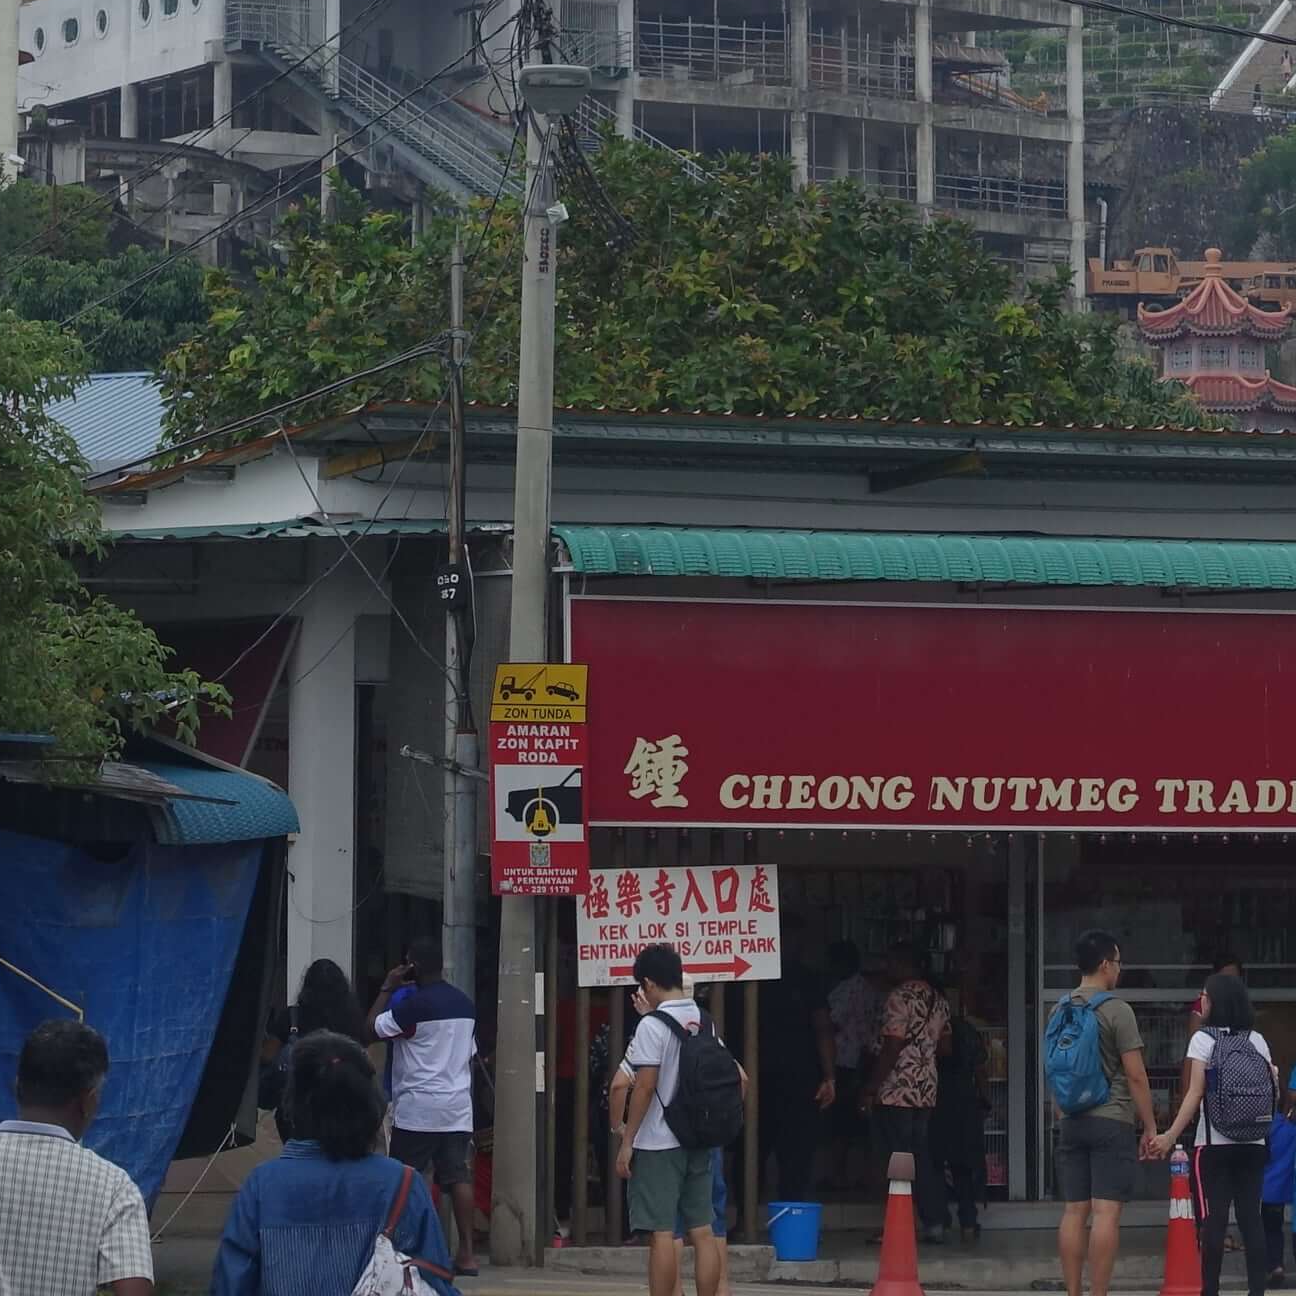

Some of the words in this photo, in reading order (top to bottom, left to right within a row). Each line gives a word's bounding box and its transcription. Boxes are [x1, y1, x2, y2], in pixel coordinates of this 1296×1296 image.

[504, 708, 529, 719] ZON
[532, 708, 572, 720] TUNDA
[507, 725, 570, 737] AMARAN
[497, 738, 529, 750] ZON
[534, 739, 579, 750] KAPIT
[518, 751, 558, 763] RODA
[623, 733, 689, 808] 鍾
[719, 773, 915, 812] CHEONG
[929, 776, 1139, 813] NUTMEG
[503, 868, 535, 876] UNTUK
[536, 868, 578, 876] BANTUAN
[517, 877, 574, 885] PERTANYAAN
[582, 865, 776, 919] 極樂寺入口處
[599, 925, 629, 941] KEK
[638, 923, 667, 939] LOK
[675, 922, 689, 936] SI
[698, 919, 758, 937] TEMPLE
[740, 937, 776, 954] PARK
